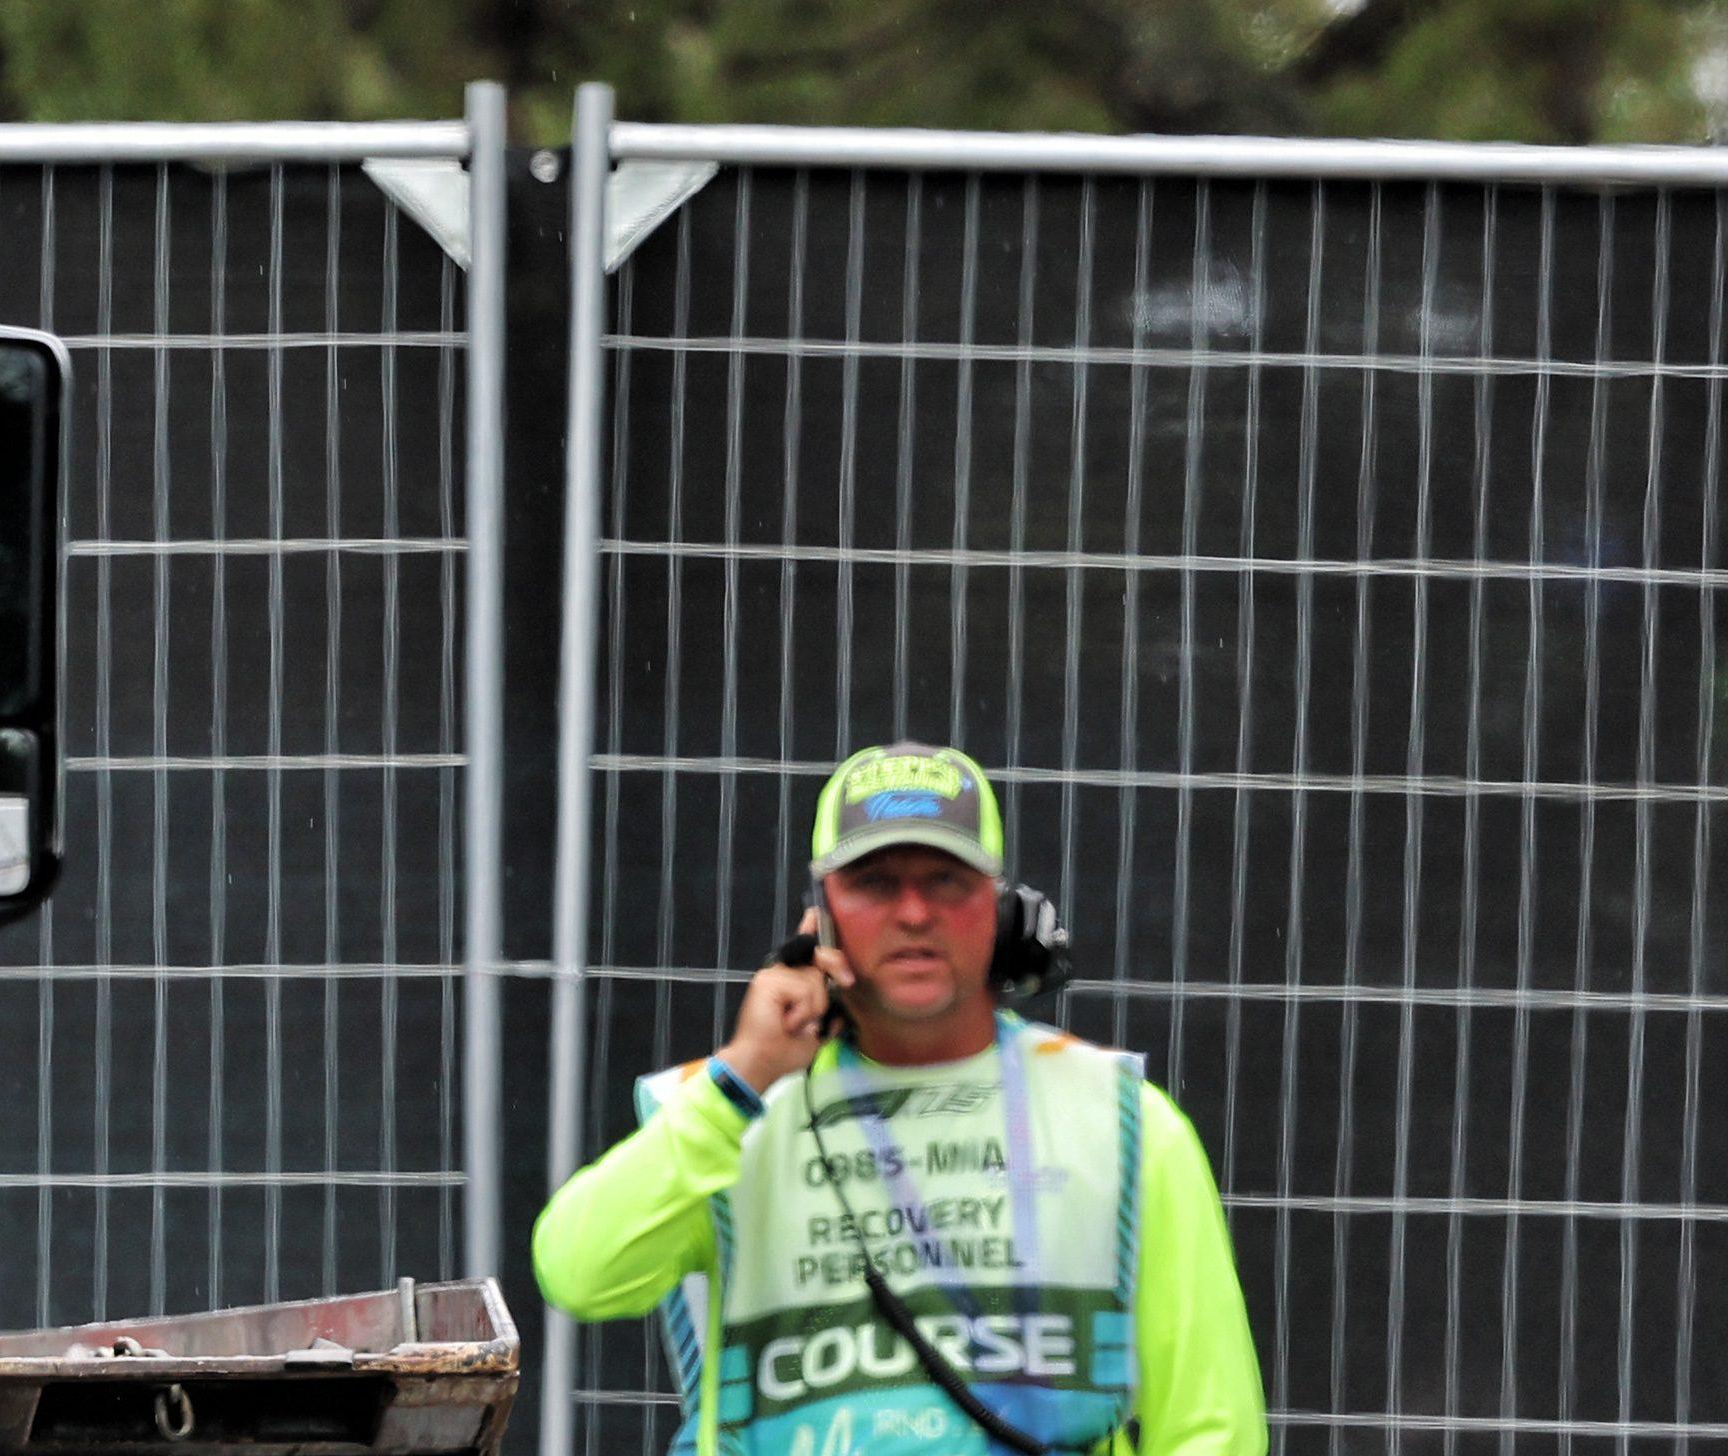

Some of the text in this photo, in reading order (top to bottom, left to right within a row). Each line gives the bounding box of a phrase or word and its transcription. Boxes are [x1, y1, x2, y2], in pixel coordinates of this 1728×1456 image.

[807, 1195, 1006, 1247] RECOVERY
[797, 1237, 1025, 1286] PERSONNEL
[757, 1313, 1077, 1401] COURSE
